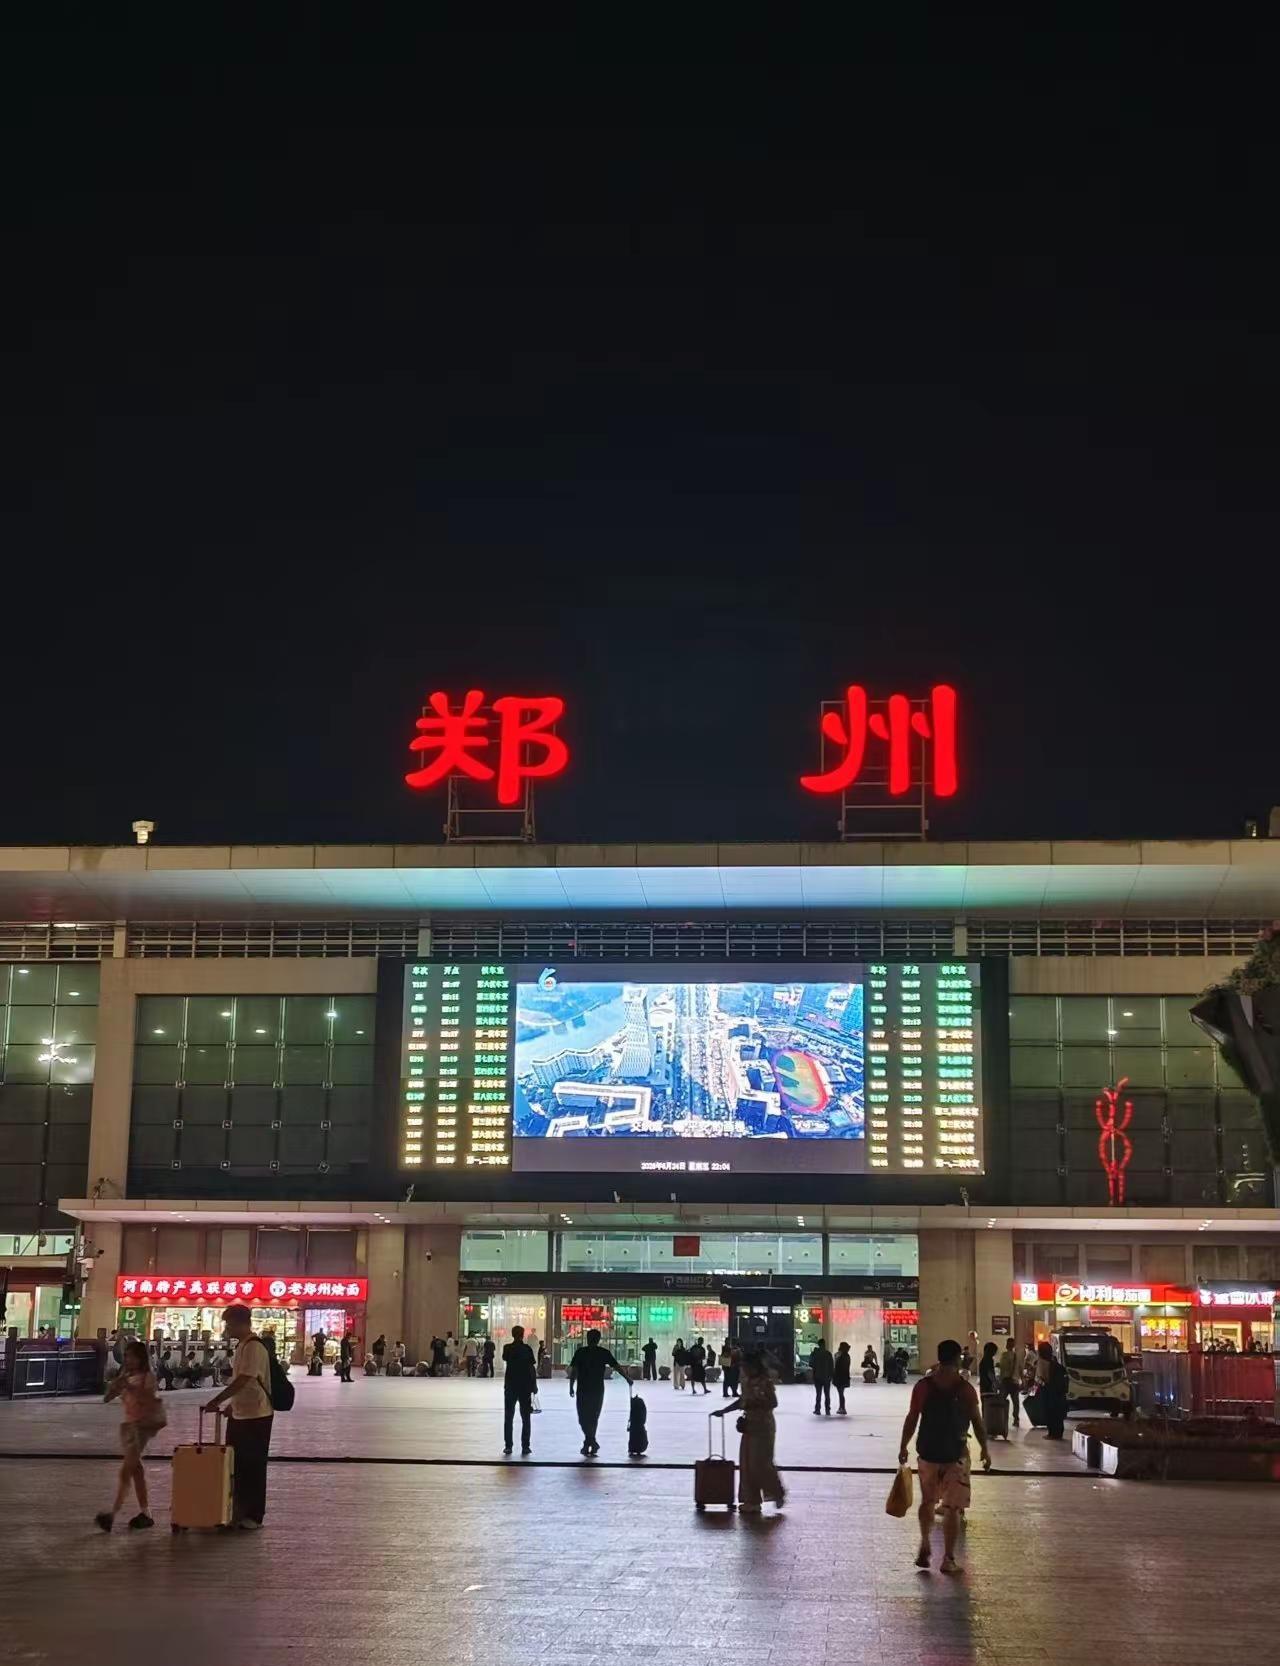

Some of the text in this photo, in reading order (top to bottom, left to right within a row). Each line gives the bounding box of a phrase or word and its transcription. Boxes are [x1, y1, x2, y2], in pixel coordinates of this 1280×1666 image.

[404, 685, 957, 804] 郑州
[711, 1162, 732, 1171] 22:04
[704, 1276, 713, 1288] 2
